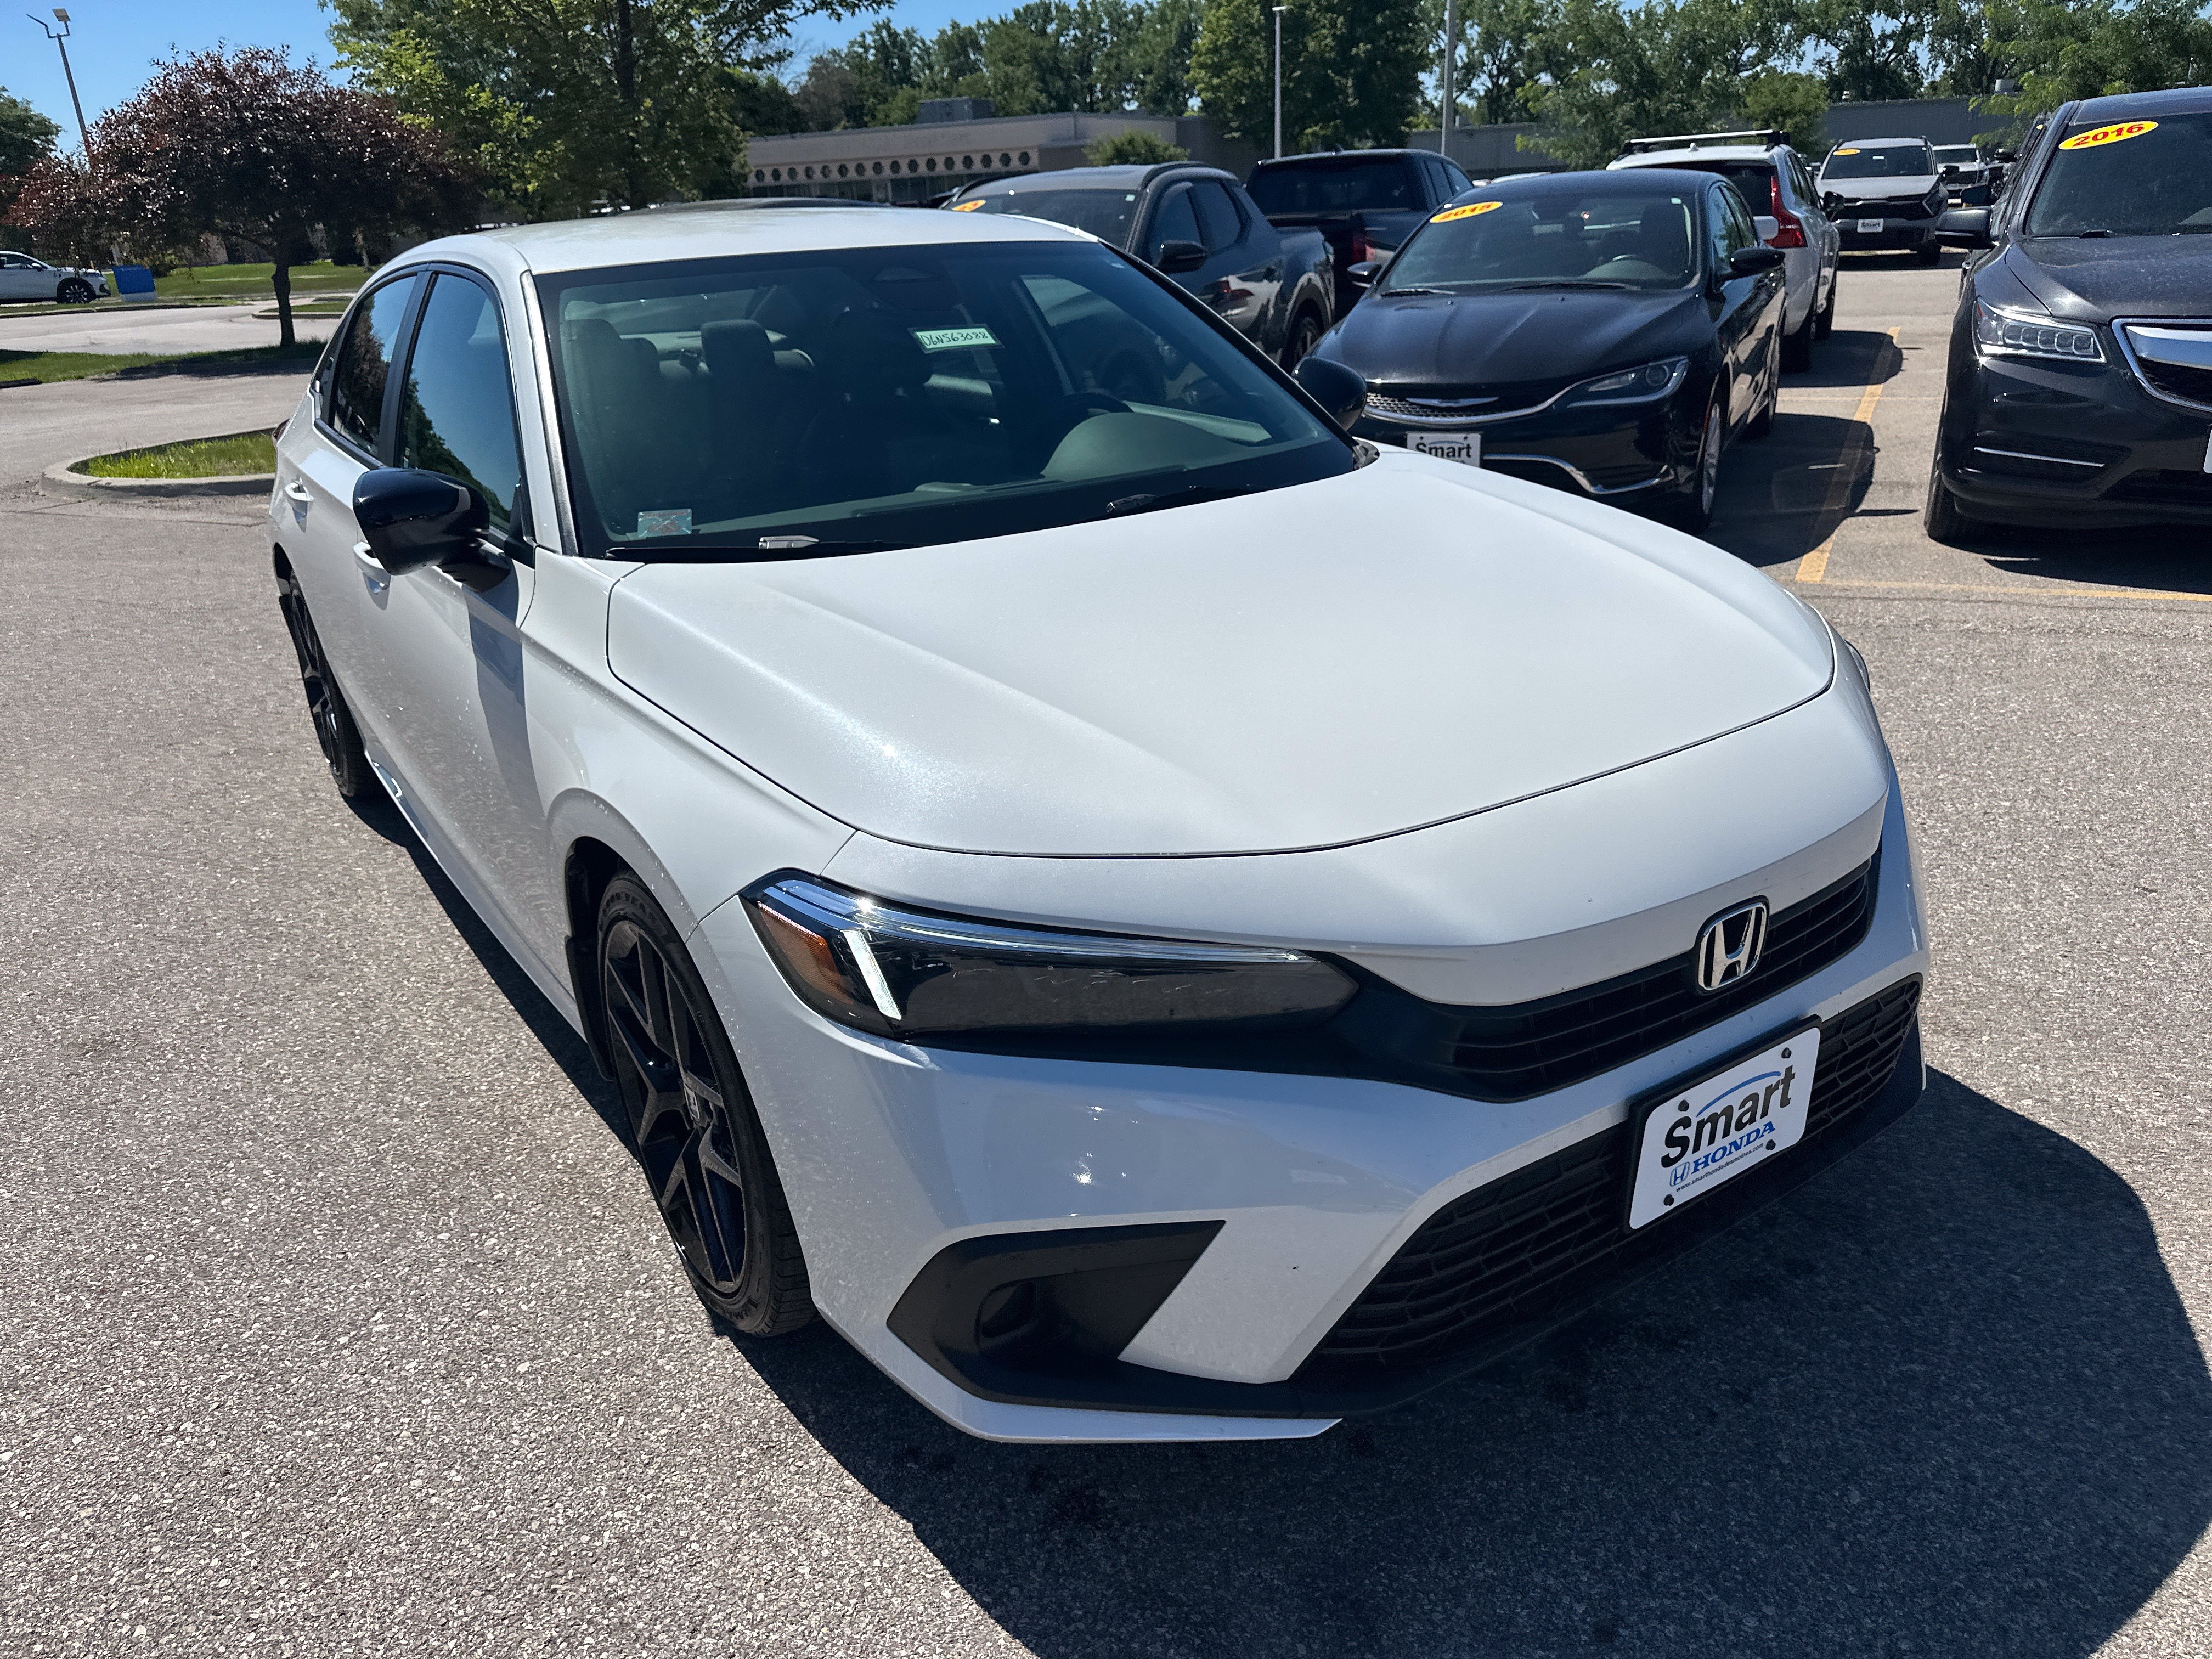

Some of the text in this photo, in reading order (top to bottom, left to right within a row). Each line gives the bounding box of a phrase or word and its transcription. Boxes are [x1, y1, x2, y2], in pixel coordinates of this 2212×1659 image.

[2072, 123, 2145, 148] 2016
[1416, 442, 1471, 458] Smart
[1661, 1064, 1796, 1168] Smart
[1691, 1121, 1776, 1175] HONDA
